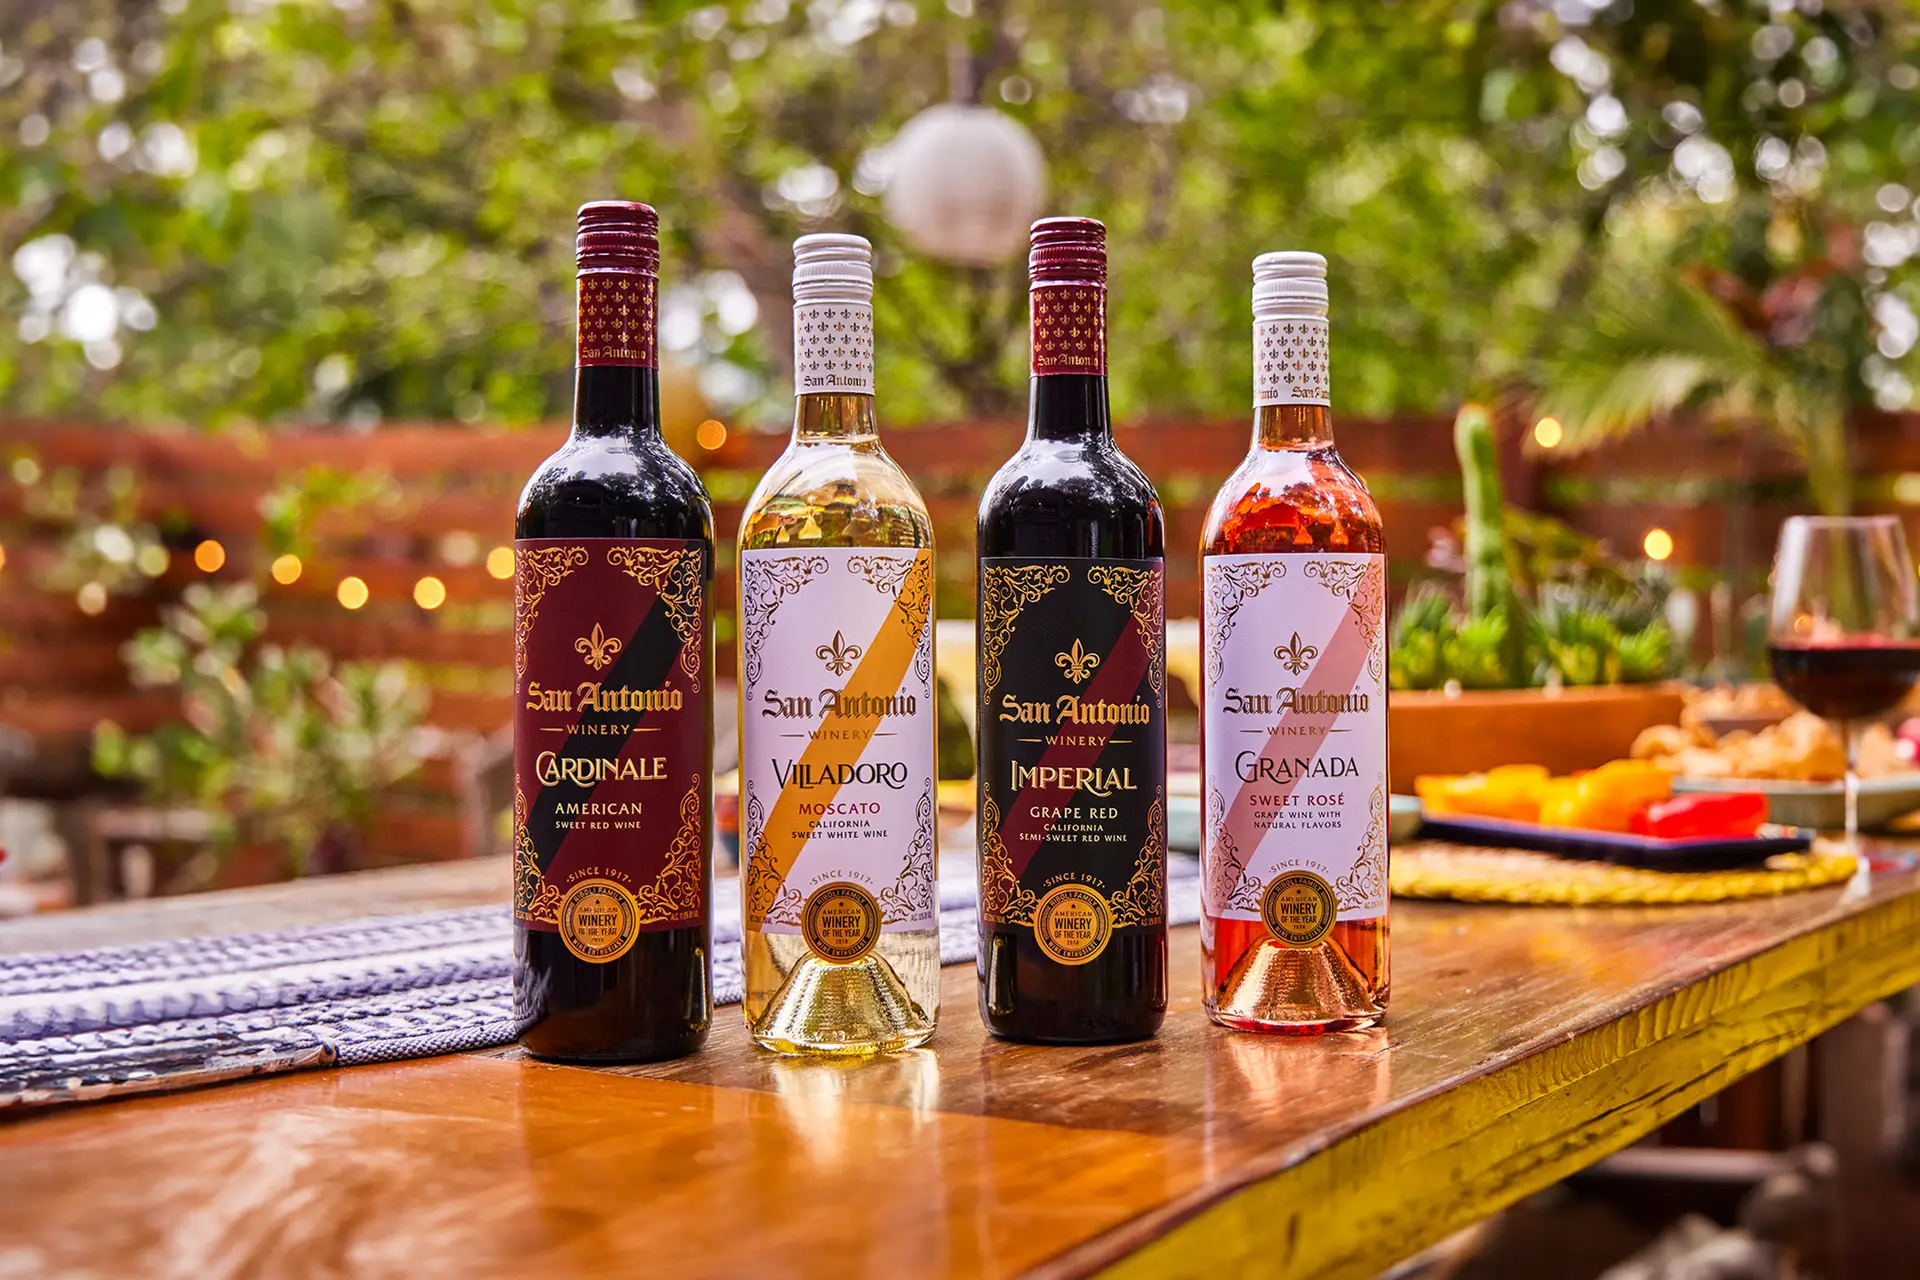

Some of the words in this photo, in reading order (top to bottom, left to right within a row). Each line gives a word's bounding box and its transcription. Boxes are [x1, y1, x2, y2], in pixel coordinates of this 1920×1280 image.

[582, 346, 600, 358] San
[1037, 355, 1057, 366] San
[804, 375, 824, 387] San
[526, 681, 572, 712] San
[576, 681, 684, 712] Antonio
[1223, 687, 1272, 715] San
[1276, 685, 1369, 715] Antonio
[762, 689, 813, 718] San
[818, 687, 917, 719] Antonio
[999, 693, 1051, 724] San
[1055, 694, 1150, 724] Antonio
[566, 724, 630, 735] WINERY
[808, 730, 872, 740] WINERY
[1267, 727, 1326, 736] WINERY
[1045, 735, 1107, 746] WINERY
[536, 750, 668, 788] CARDINALE
[1235, 750, 1359, 784] GRANADA
[771, 758, 908, 790] VILLADORO
[1010, 760, 1138, 797] IMPERIAL
[1249, 795, 1299, 806] SWEET
[1308, 792, 1344, 806] ROSÉ
[555, 802, 642, 815] AMERICAN
[798, 802, 881, 816] MOSCATO
[1030, 806, 1081, 819] GRAPE
[1090, 807, 1118, 819] RED
[1254, 811, 1284, 819] GRAPE
[555, 821, 586, 830] SWEET
[590, 822, 610, 830] RED
[614, 821, 642, 829] WINE
[809, 820, 870, 828] CALIFORNIA
[1044, 823, 1104, 832] CALIFORNIA
[1254, 821, 1296, 829] NATURAL
[1301, 821, 1342, 829] FLAVORS
[792, 831, 823, 839] SWEET
[827, 831, 859, 839] WHITE
[863, 829, 888, 838] WINE
[1019, 832, 1077, 842] SEMI-SWEET
[1082, 834, 1100, 842] RED
[1105, 834, 1127, 842] WINE
[1280, 903, 1317, 914] WINERY
[578, 914, 618, 926] WINERY
[822, 916, 861, 928] WINERY
[1054, 918, 1092, 929] WINERY
[822, 929, 831, 937] OF
[832, 929, 843, 937] THE
[845, 929, 860, 937] YEAR
